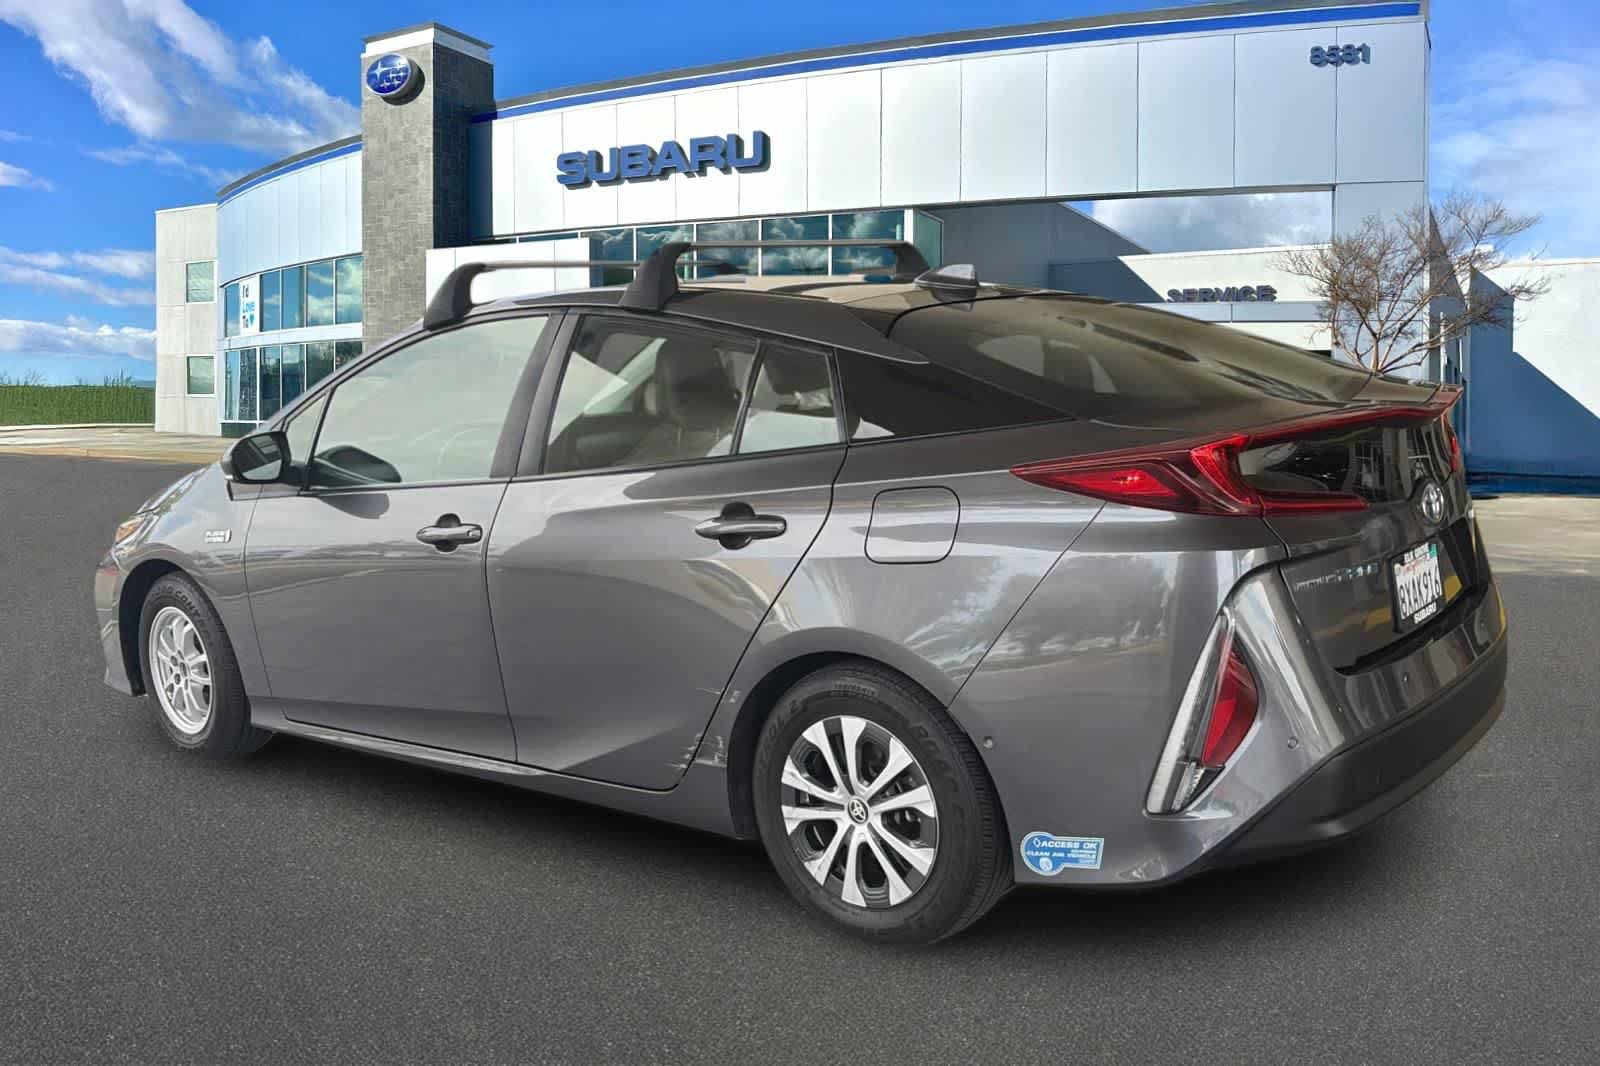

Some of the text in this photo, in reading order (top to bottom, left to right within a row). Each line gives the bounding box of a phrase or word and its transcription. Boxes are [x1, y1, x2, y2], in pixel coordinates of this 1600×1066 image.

[556, 131, 769, 189] SUBARU
[1167, 285, 1277, 302] SERVICE
[1399, 565, 1442, 618] 8XAK916
[1414, 602, 1438, 624] SUBARU
[1041, 840, 1080, 849] ACCESS
